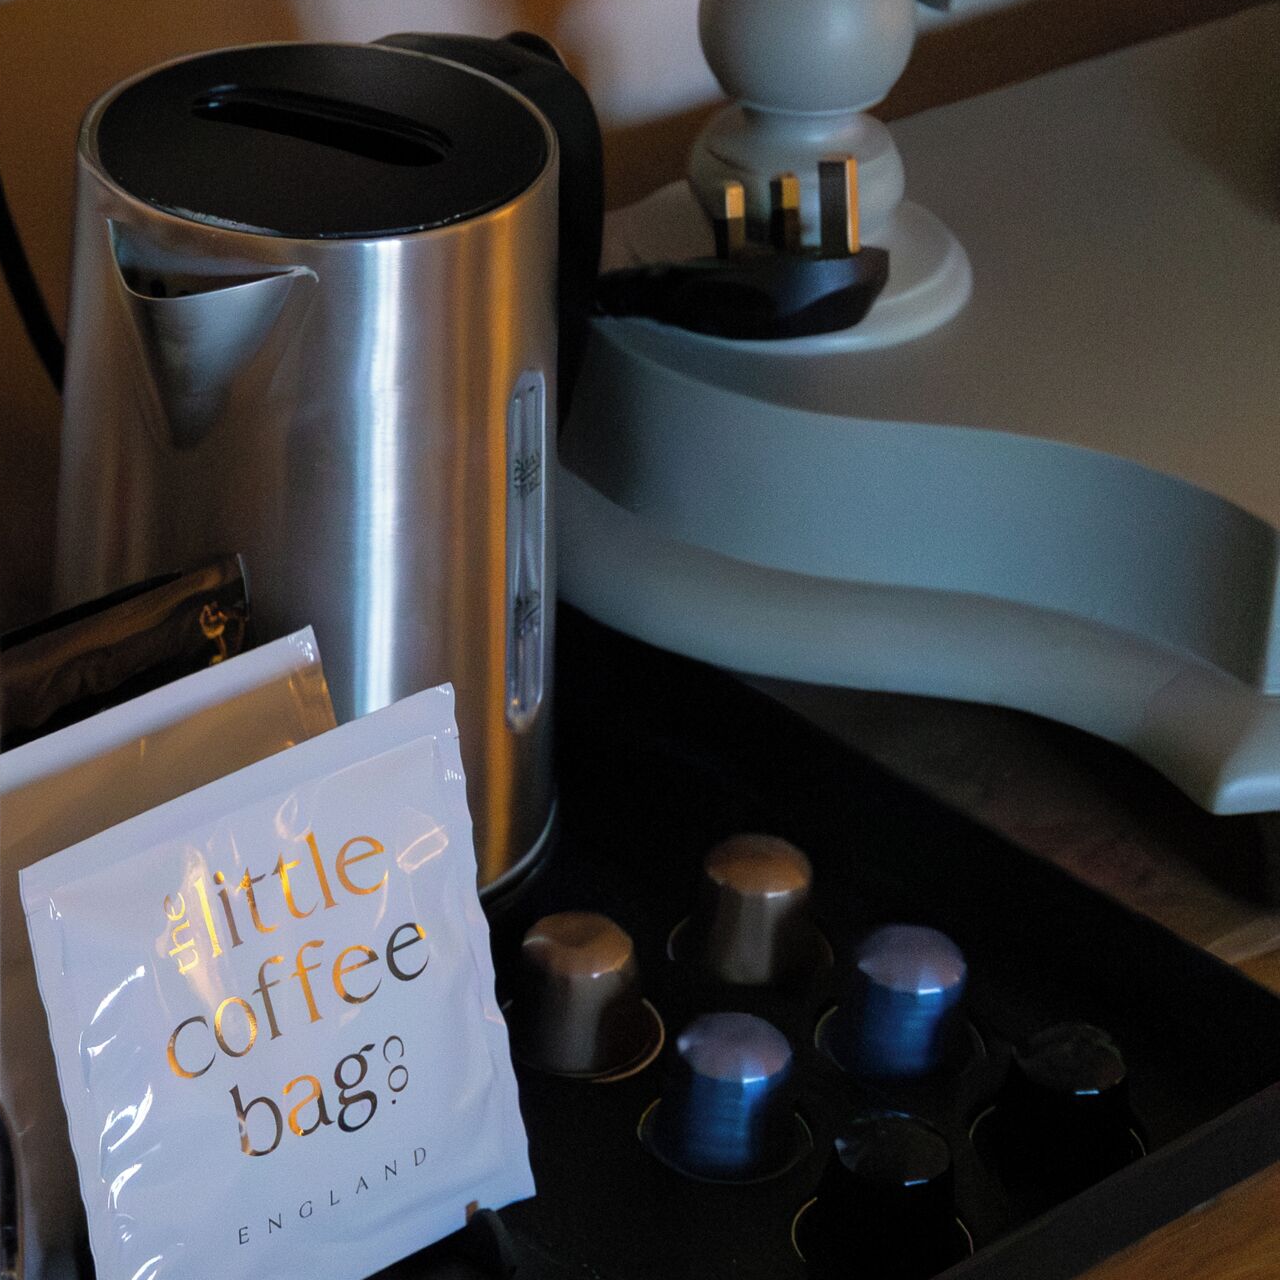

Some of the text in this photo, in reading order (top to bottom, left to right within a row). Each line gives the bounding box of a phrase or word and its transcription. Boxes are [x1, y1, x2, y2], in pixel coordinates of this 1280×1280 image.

[163, 831, 388, 976] the little
[166, 921, 430, 1081] coffee
[229, 1043, 377, 1157] bag
[238, 1146, 427, 1246] ENGLAND
